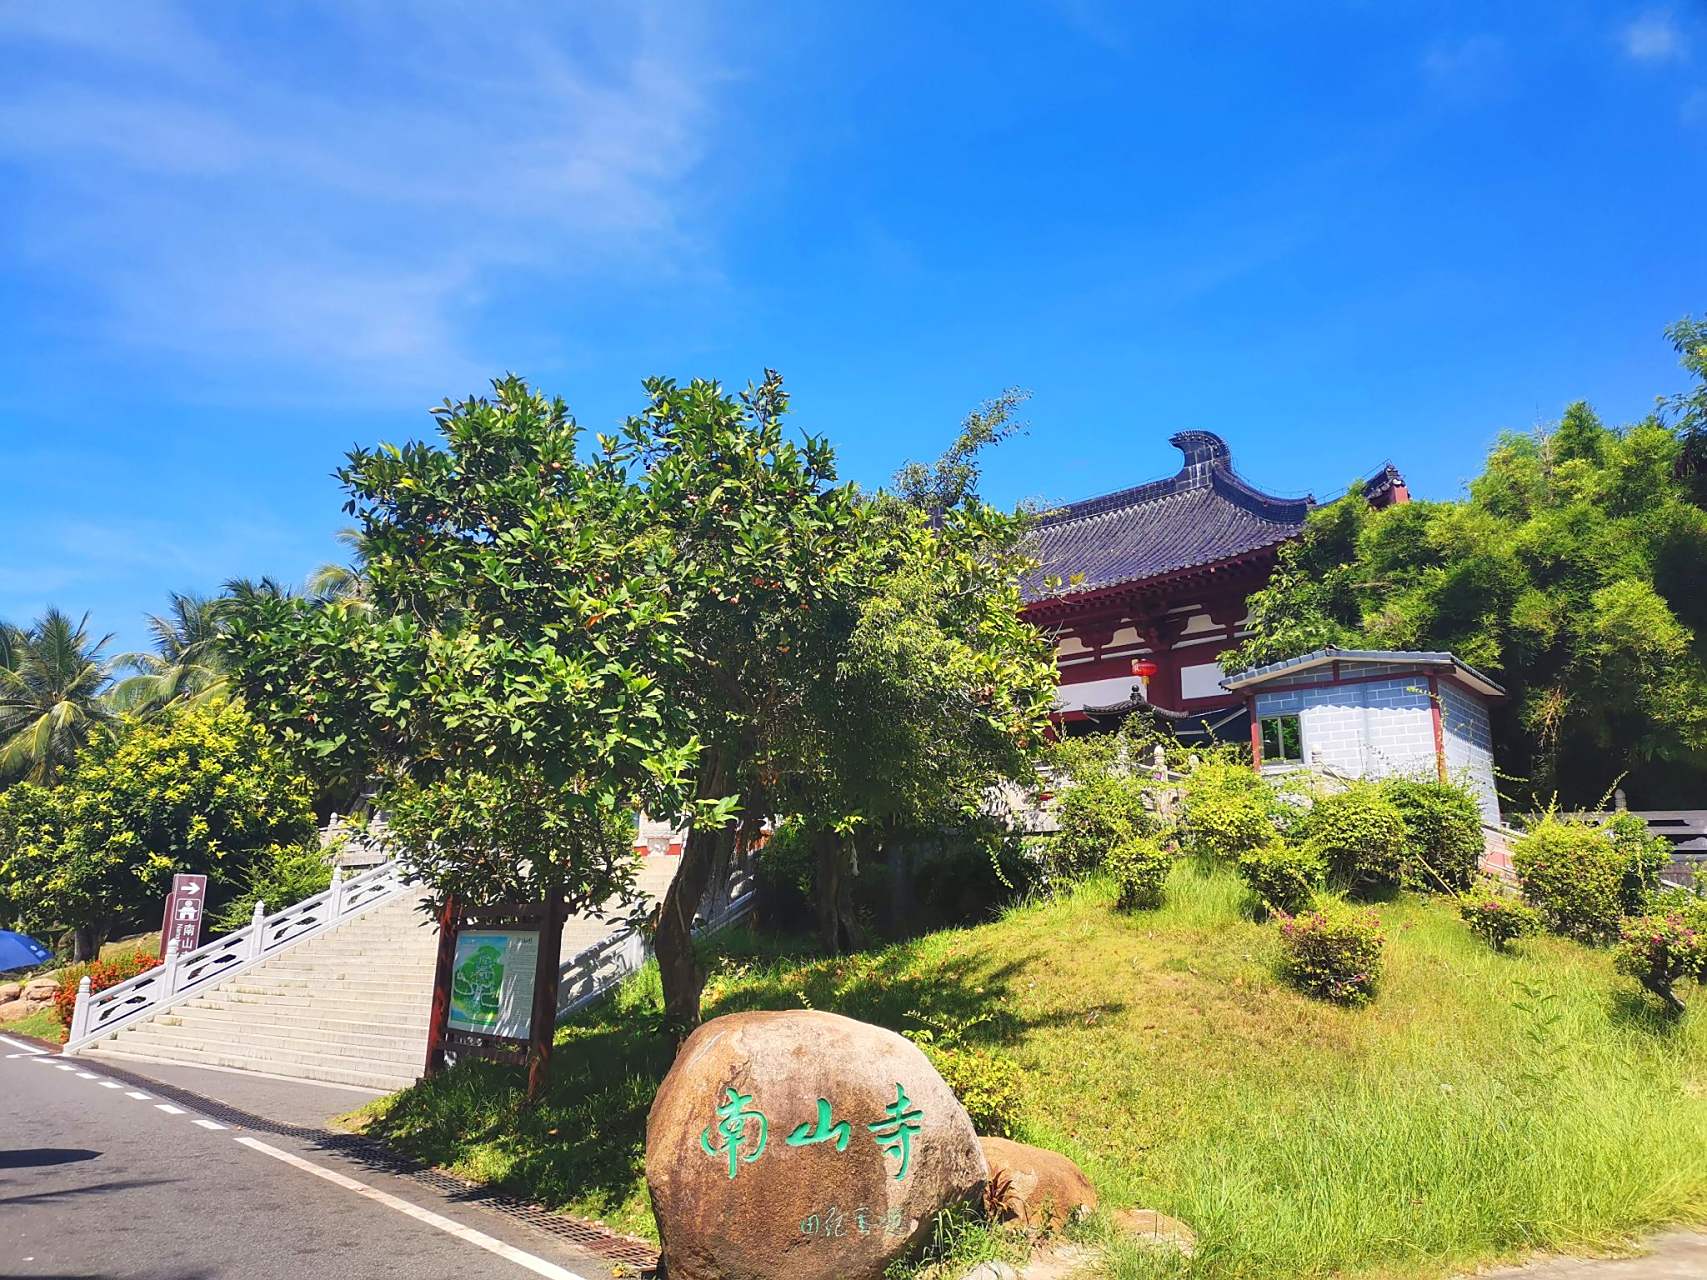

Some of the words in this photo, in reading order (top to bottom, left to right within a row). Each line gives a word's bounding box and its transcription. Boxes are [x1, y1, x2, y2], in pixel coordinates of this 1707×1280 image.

[181, 924, 196, 954] 南山
[700, 1081, 926, 1182] 南山寺
